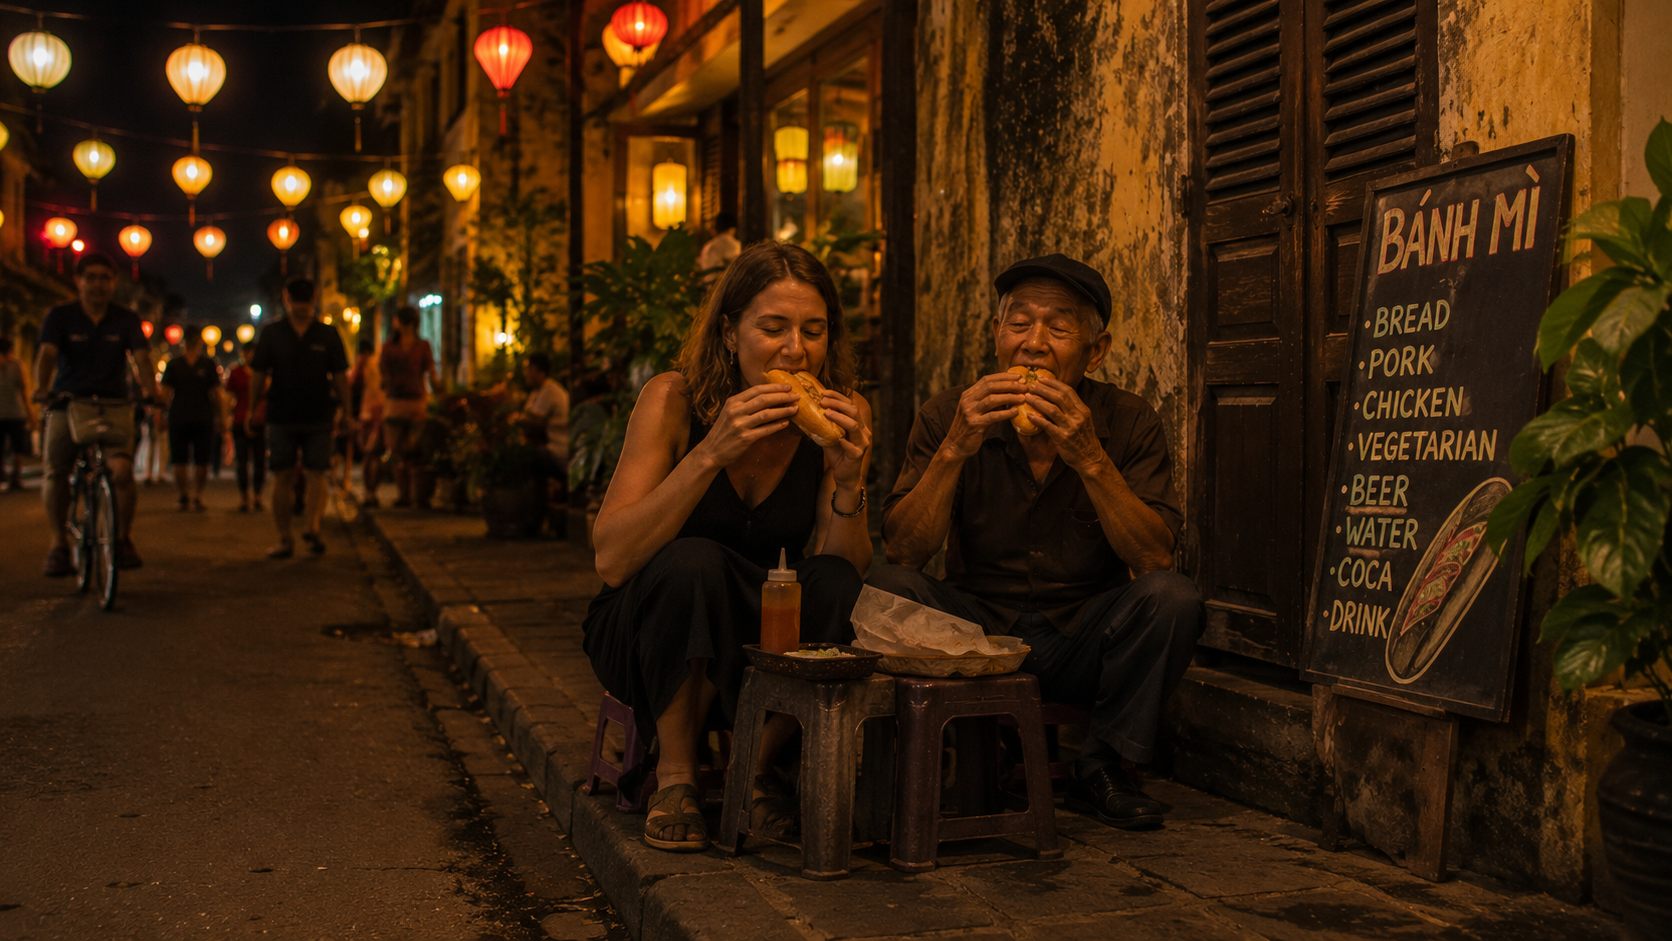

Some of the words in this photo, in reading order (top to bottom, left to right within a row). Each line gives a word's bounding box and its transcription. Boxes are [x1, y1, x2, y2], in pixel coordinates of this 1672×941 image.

[1377, 189, 1480, 275] BÁNH
[1488, 164, 1541, 256] MÌ
[1373, 299, 1451, 338] BREAD
[1367, 344, 1435, 379] PORK
[1362, 386, 1464, 420] CHICKEN
[1358, 429, 1498, 461] VEGETARIAN
[1350, 474, 1410, 507] BEER
[1346, 516, 1419, 550] WATER
[1337, 557, 1393, 591] COCA
[1329, 599, 1391, 640] DRINK
